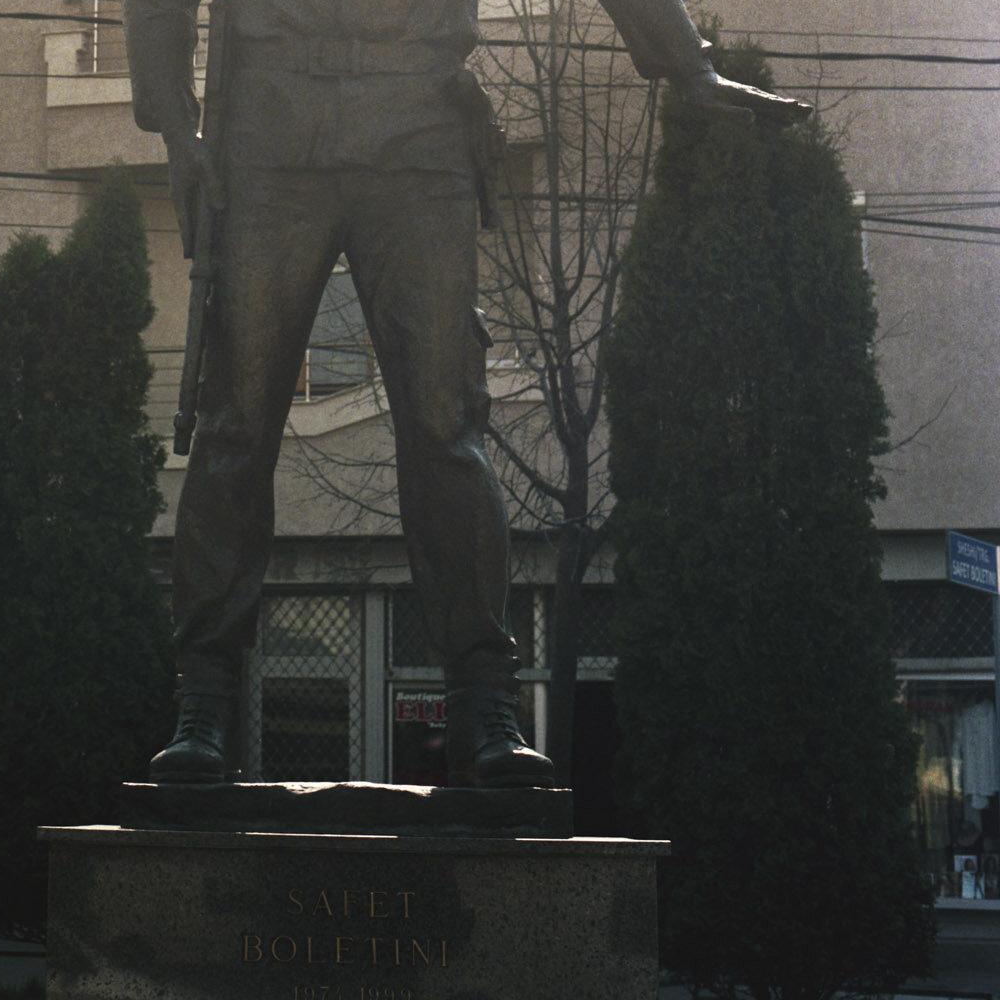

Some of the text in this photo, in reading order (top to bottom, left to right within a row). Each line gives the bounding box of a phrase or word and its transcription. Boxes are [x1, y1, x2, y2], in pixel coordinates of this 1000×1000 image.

[952, 560, 969, 579] SAFET
[396, 691, 446, 703] Boutique
[289, 888, 416, 919] SAFET
[243, 935, 448, 967] BOLETINI
